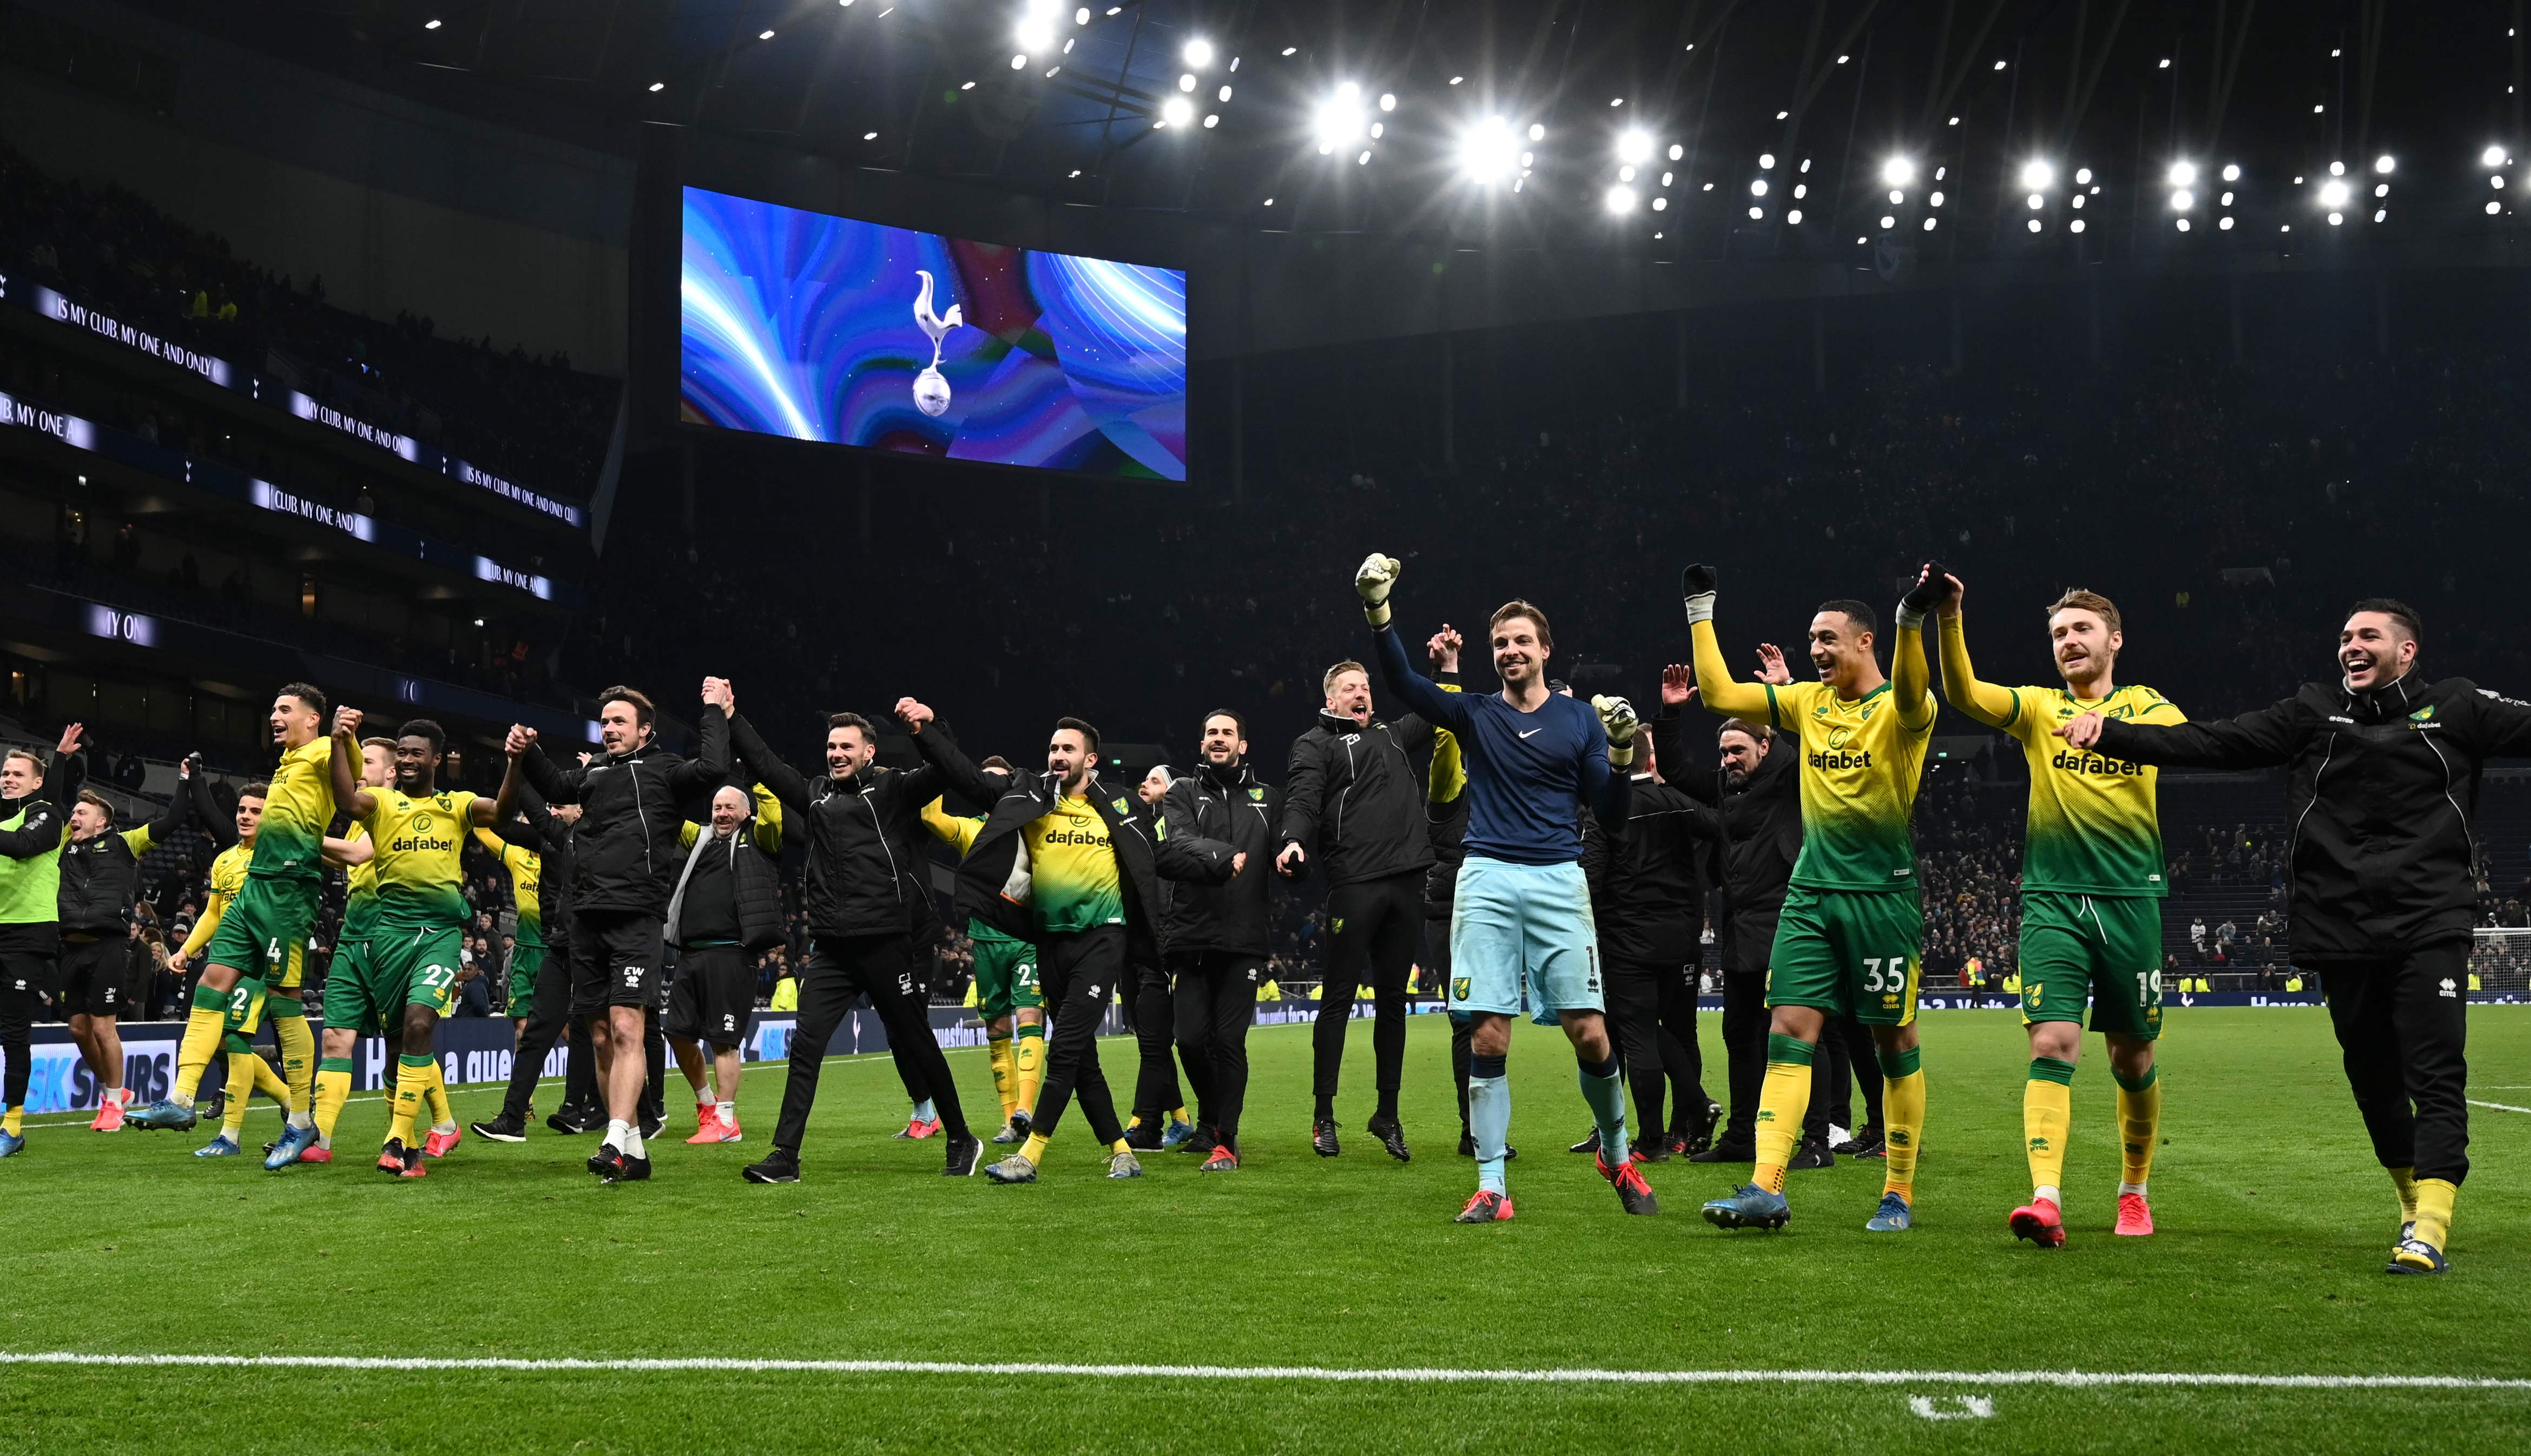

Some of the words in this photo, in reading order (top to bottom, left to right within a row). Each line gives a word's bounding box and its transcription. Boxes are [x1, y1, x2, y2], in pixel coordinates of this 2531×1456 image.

[57, 297, 68, 320] IS
[70, 303, 87, 326] MY
[90, 312, 118, 340] CLUB,
[121, 325, 137, 347] MY
[140, 332, 160, 357] ONE
[163, 342, 183, 365] AND
[186, 350, 211, 376] ONLY
[17, 402, 36, 427] MY
[39, 411, 64, 438] ONE
[306, 399, 319, 420] MY
[320, 406, 342, 431] CLUB,
[344, 415, 356, 434] MY
[358, 421, 373, 441] ONE
[374, 428, 391, 448] AND
[476, 469, 482, 486] IS
[483, 472, 493, 489] MY
[511, 484, 522, 502] MY
[522, 489, 535, 507] ONE
[535, 495, 548, 513] AND
[549, 500, 564, 518] ONLY
[275, 489, 299, 515] CLUB,
[300, 499, 314, 519] MY
[316, 504, 334, 526] ONE
[335, 511, 354, 532] AND
[503, 567, 513, 585] MY
[515, 572, 528, 590] ONE
[1808, 748, 1872, 772] dafabet
[2052, 749, 2144, 776] dafabet
[392, 836, 452, 852] dafabet
[1045, 829, 1113, 848] dafabet
[267, 937, 282, 963] 4
[1585, 945, 1596, 977] 1
[427, 964, 455, 989] 27
[623, 966, 645, 976] EW
[898, 972, 911, 984] CJ
[1863, 956, 1905, 993] 35
[232, 987, 248, 1010] 2
[2136, 969, 2162, 1007] 19
[2438, 990, 2456, 998] errea
[723, 1014, 735, 1023] PD
[444, 1051, 461, 1084] a
[72, 1053, 172, 1111] SRS
